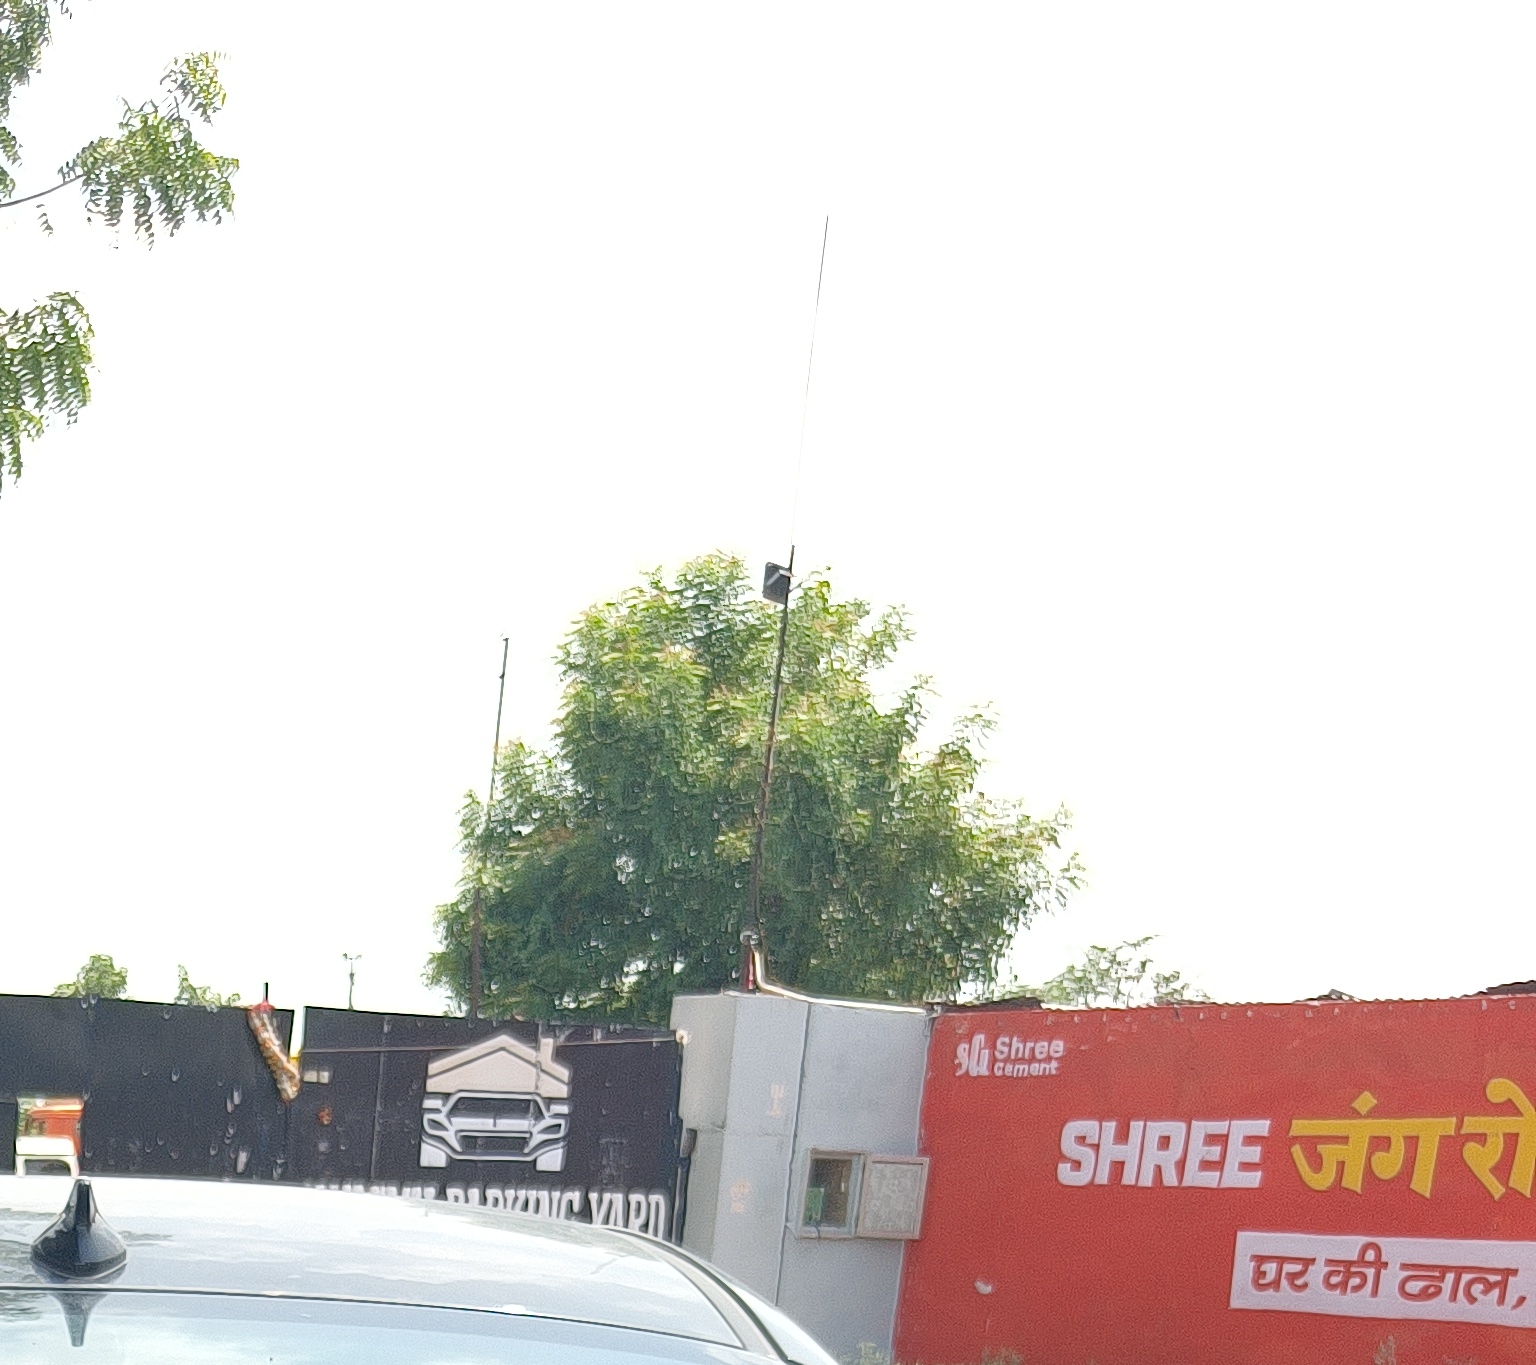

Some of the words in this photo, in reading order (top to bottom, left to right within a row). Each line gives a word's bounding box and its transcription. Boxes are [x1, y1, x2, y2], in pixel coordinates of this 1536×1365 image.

[994, 1035, 1064, 1060] Shree
[1057, 1118, 1271, 1189] SHREE
[1289, 1090, 1457, 1199] जंग
[1248, 1253, 1316, 1295] घर
[1321, 1241, 1388, 1298] की
